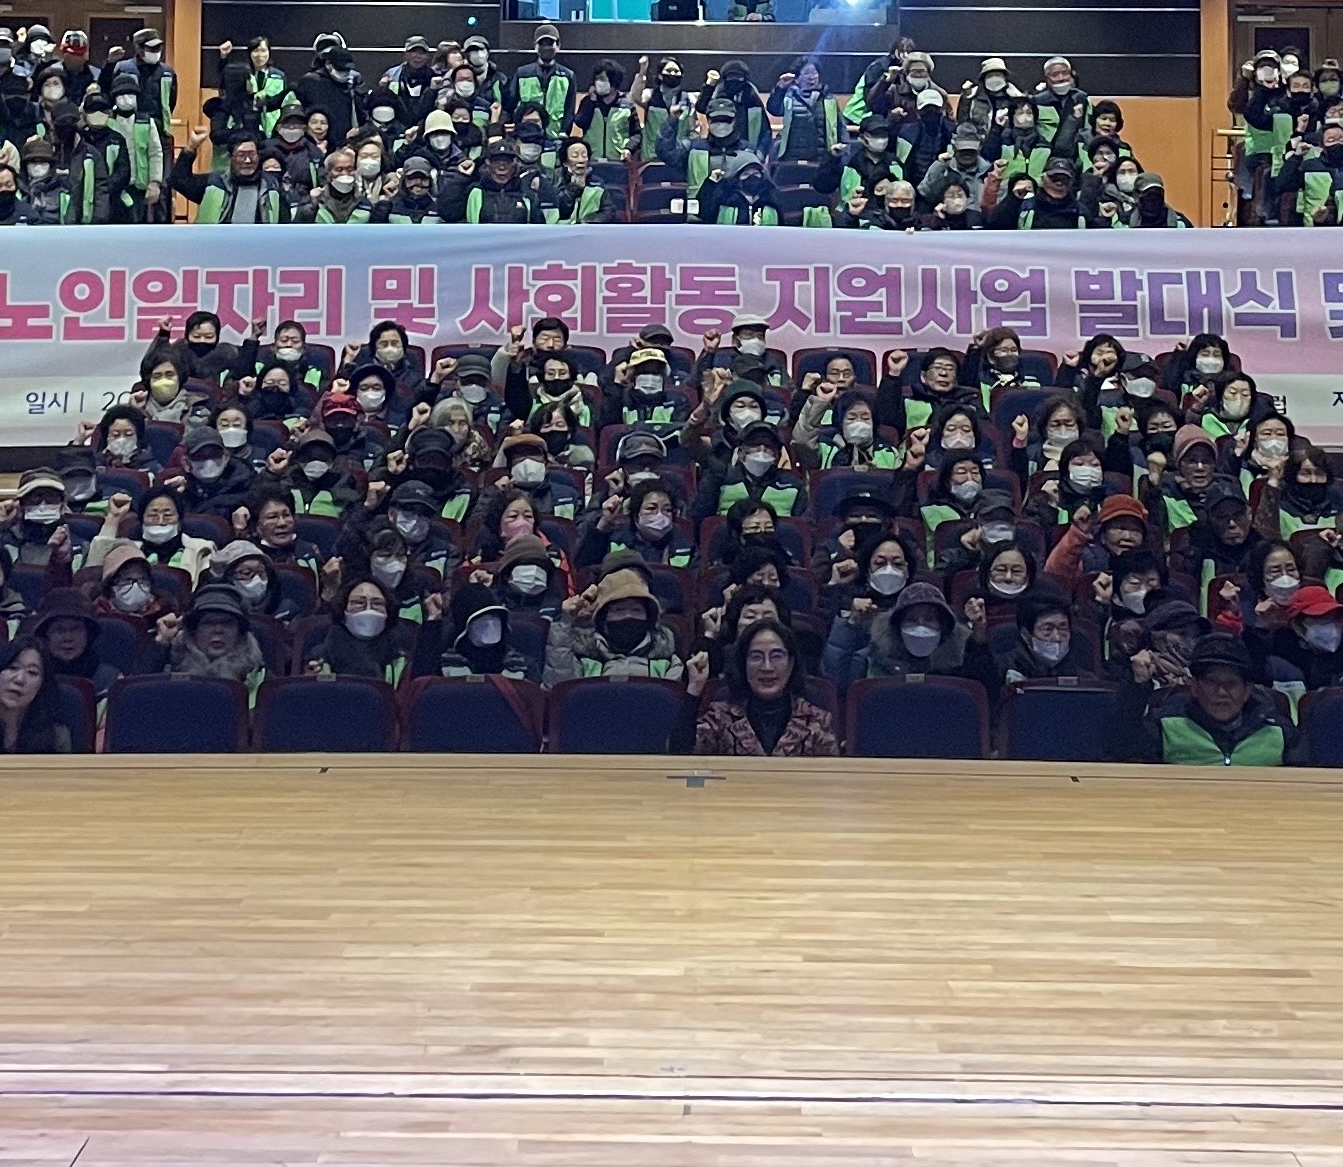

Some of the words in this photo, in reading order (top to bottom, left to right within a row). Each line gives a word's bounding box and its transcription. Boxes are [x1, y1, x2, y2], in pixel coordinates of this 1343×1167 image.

[370, 266, 438, 337] 및
[457, 262, 742, 335] 사회활동
[763, 265, 1049, 337] 지원사업
[1073, 269, 1299, 339] 발대식
[25, 391, 69, 415] 일시
